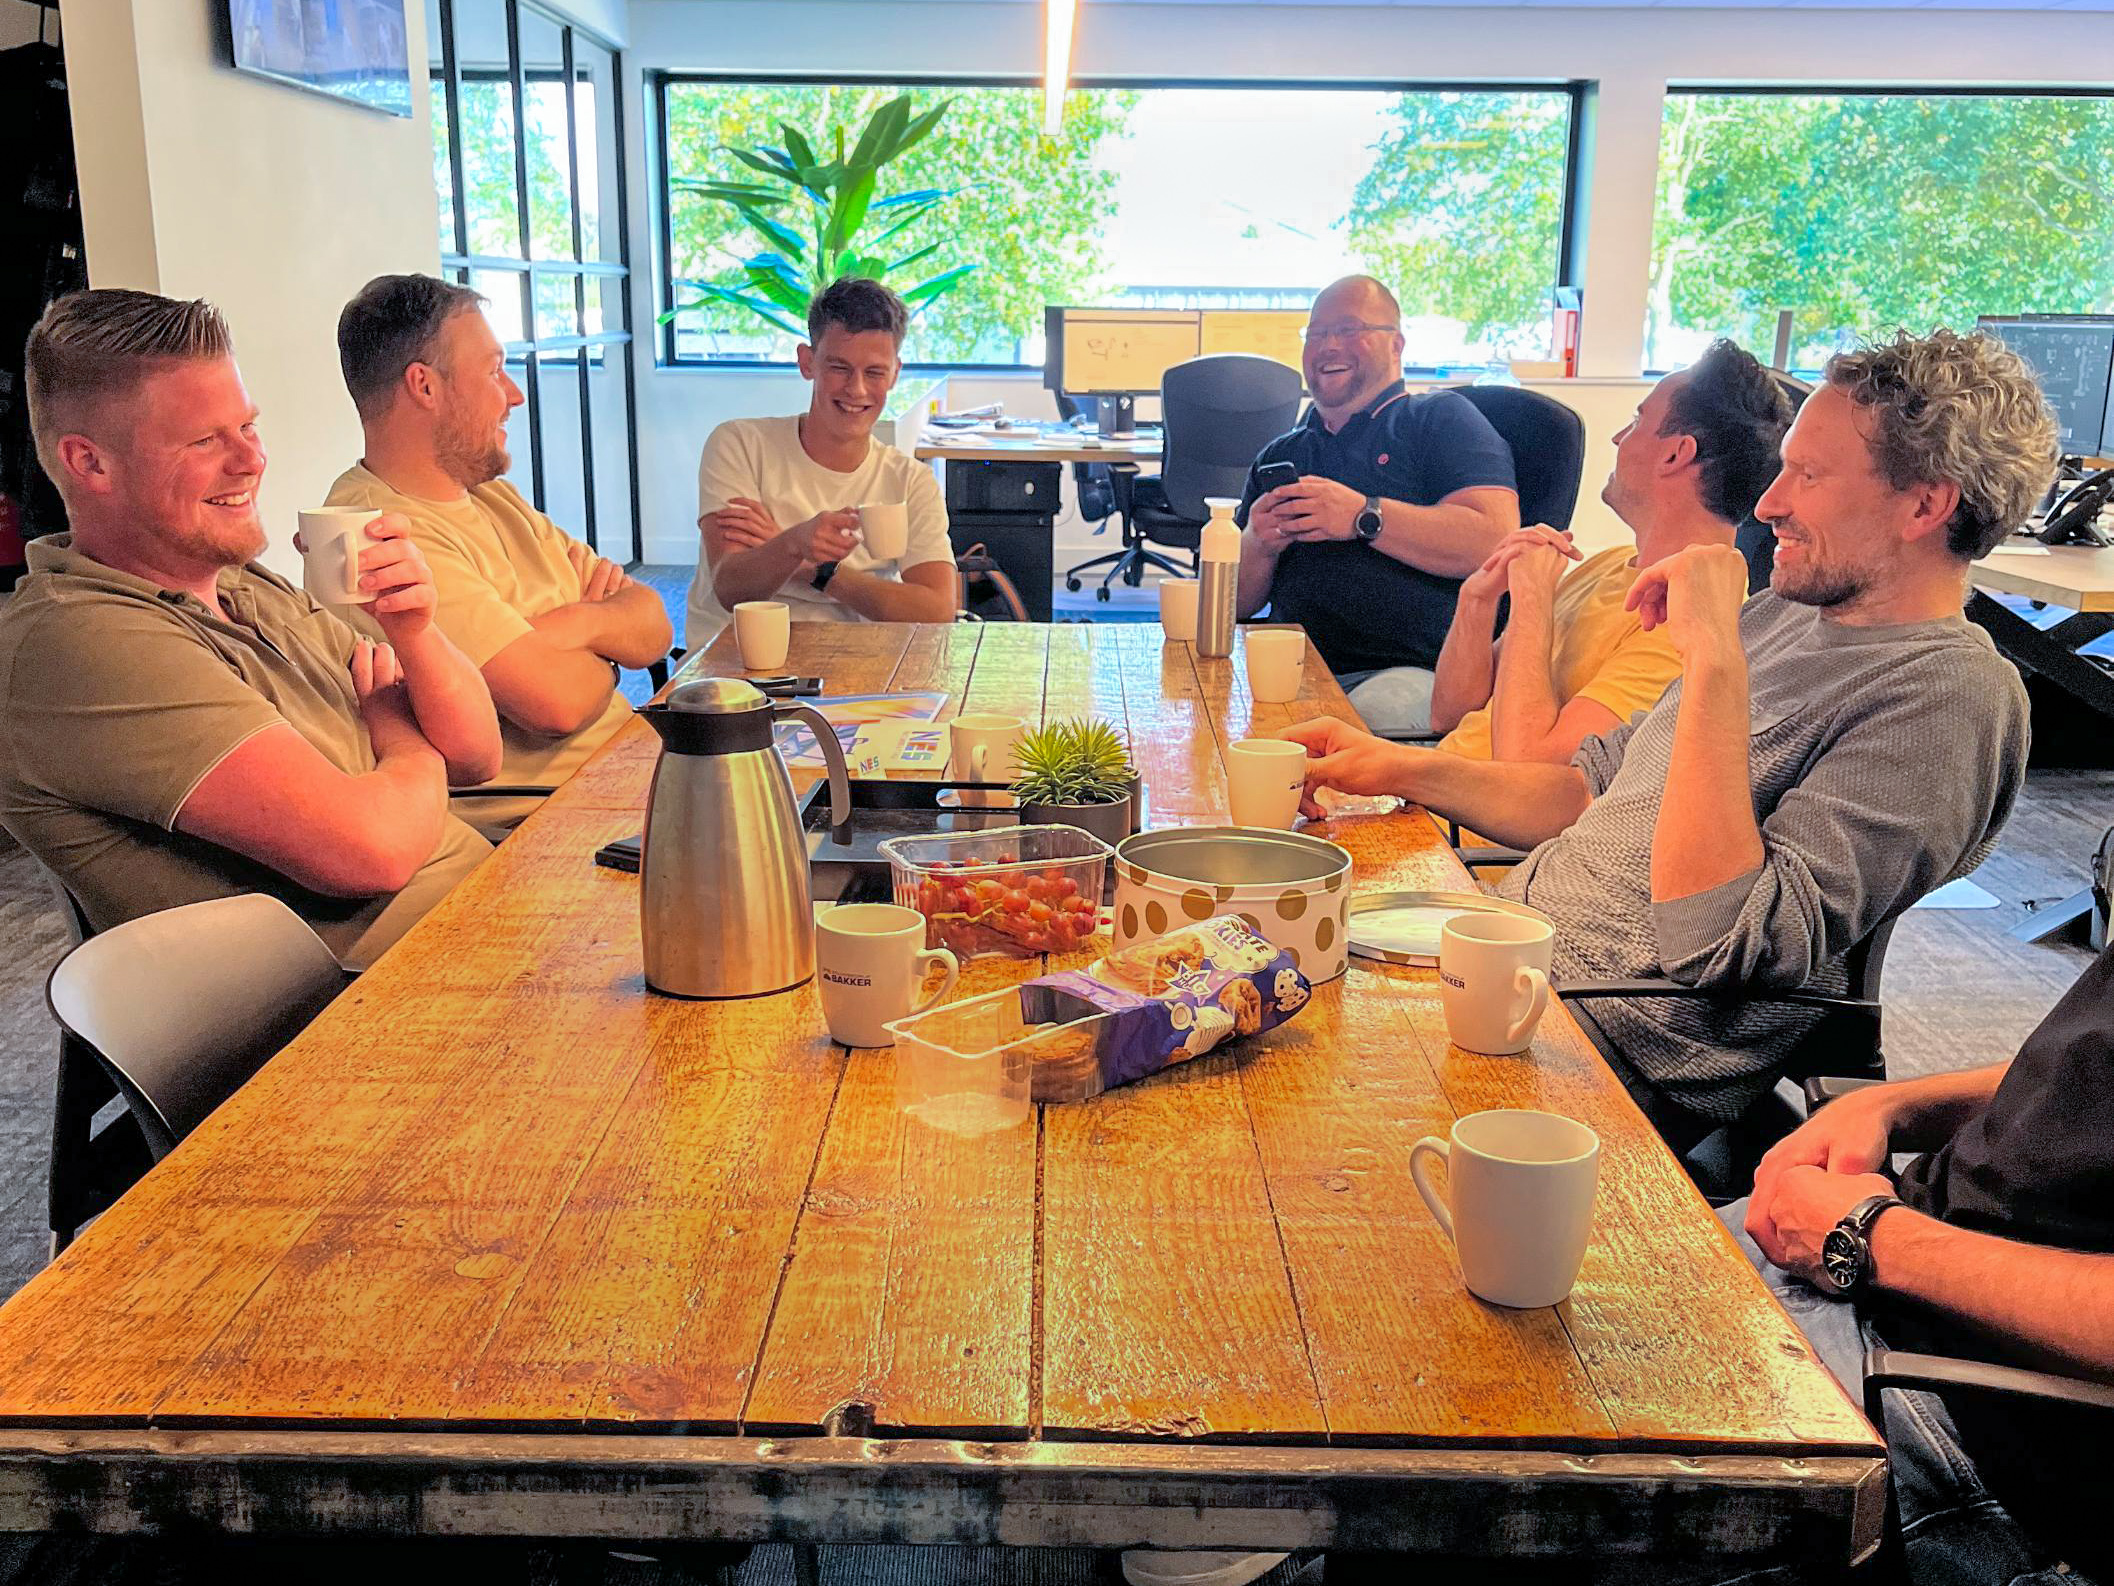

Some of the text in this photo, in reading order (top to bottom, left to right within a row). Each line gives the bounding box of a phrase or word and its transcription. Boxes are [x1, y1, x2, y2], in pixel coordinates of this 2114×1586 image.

[901, 730, 943, 760] NES
[859, 755, 880, 774] NES
[831, 974, 872, 987] BAKKER
